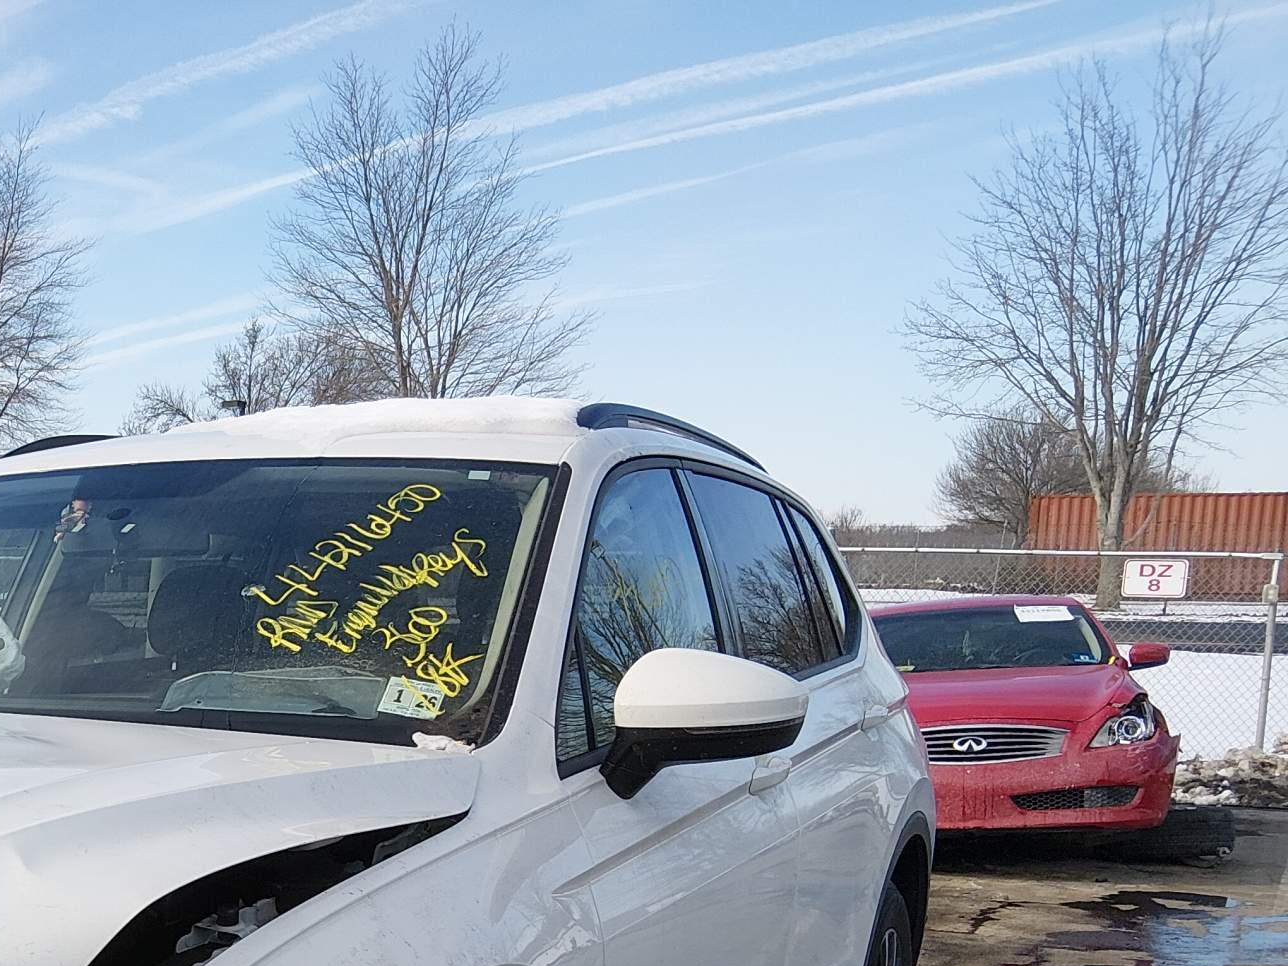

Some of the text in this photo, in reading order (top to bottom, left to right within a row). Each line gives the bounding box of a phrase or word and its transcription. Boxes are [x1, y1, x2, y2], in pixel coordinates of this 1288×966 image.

[250, 484, 441, 605] 44216450
[1139, 564, 1174, 578] DZ
[1148, 579, 1161, 592] 8
[393, 689, 404, 703] 1
